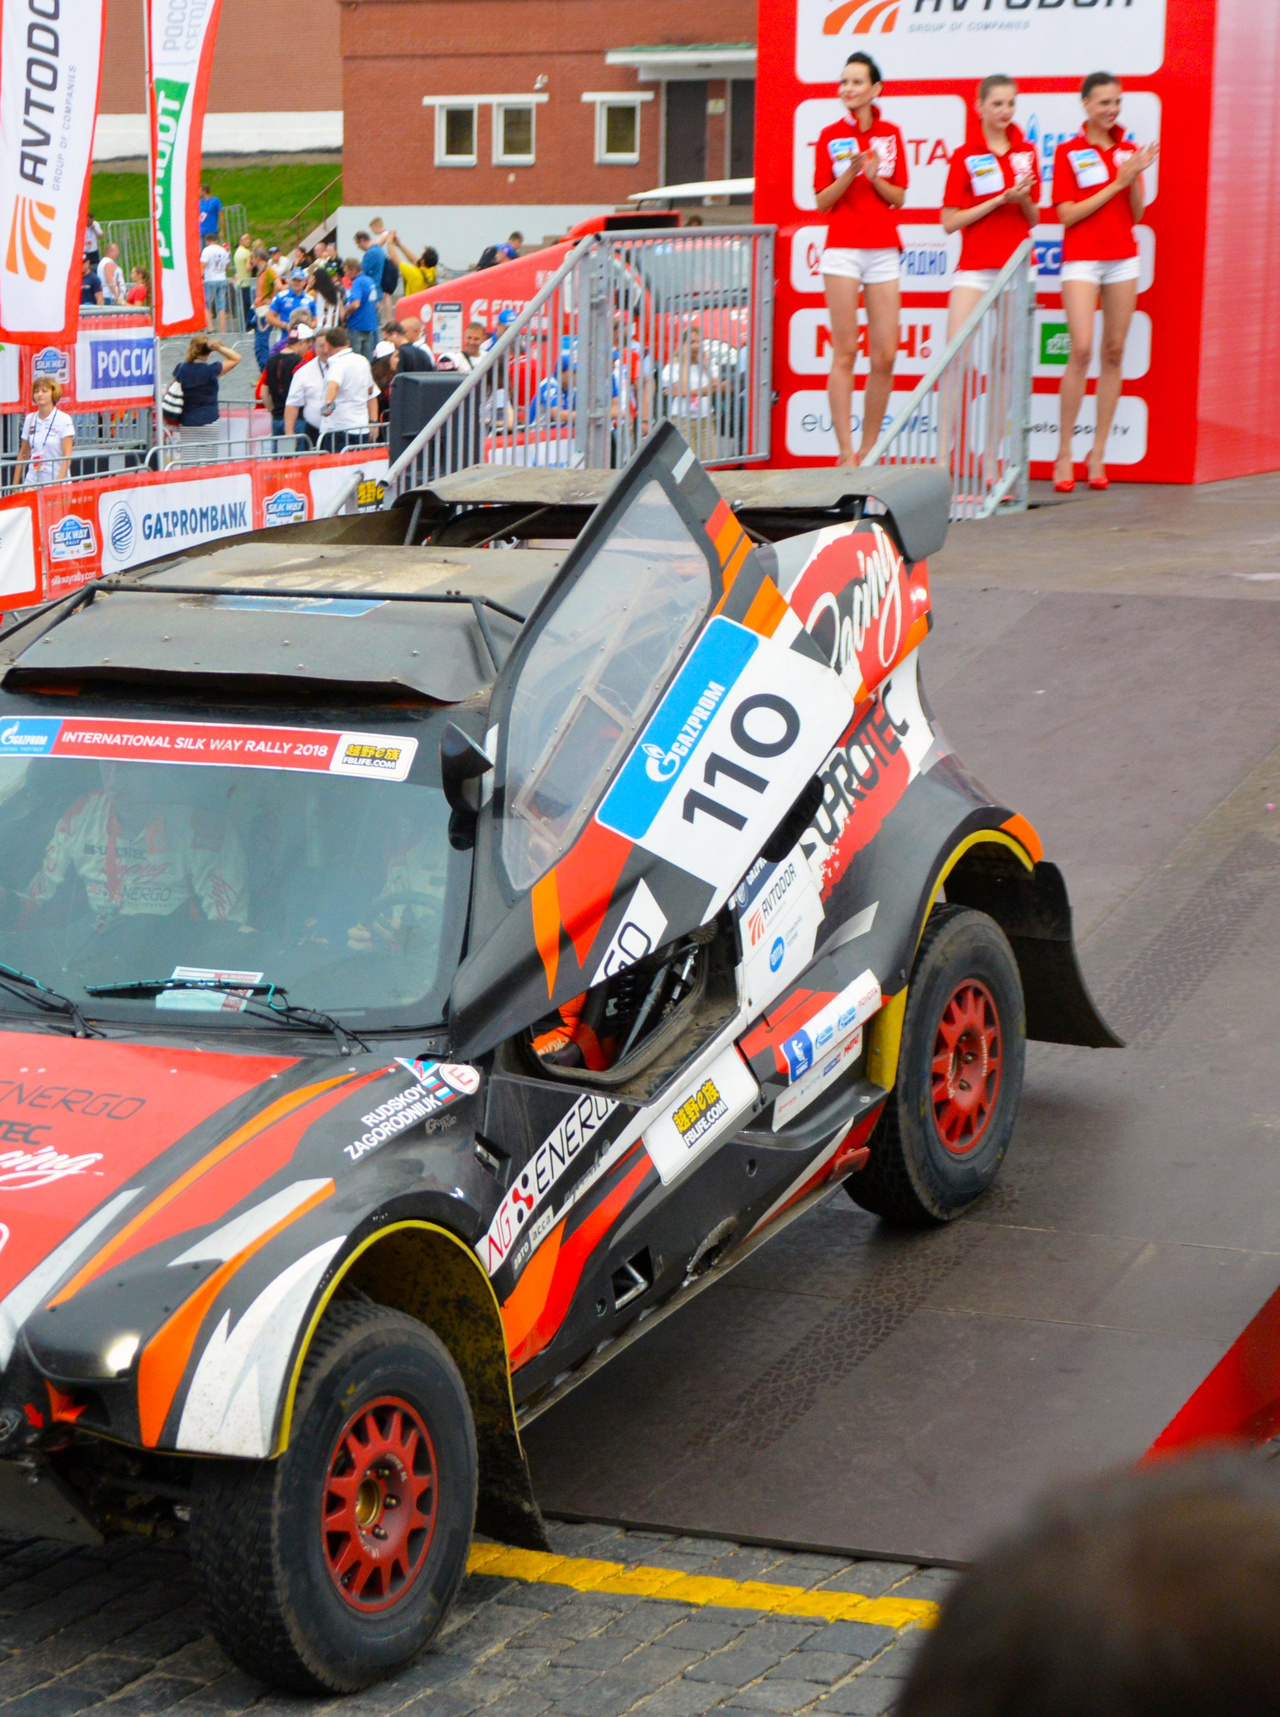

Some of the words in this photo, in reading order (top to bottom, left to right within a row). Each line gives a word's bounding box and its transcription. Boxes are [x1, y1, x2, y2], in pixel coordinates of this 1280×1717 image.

[908, 23, 946, 33] GROUP
[950, 21, 964, 32] OF
[967, 19, 1032, 31] COMPANIES
[63, 65, 77, 131] COMPANIES
[59, 136, 69, 149] OF
[52, 153, 64, 191] GROUP
[97, 348, 156, 378] РОССИ
[142, 501, 248, 541] GAZPROMBANK
[671, 680, 726, 758] GAZPROM
[61, 731, 172, 748] INTERNATIONAL
[174, 736, 206, 751] SILK
[209, 738, 243, 752] WAY
[244, 740, 292, 755] RALLY
[293, 743, 329, 758] 2018
[341, 756, 397, 770] FBLIFE.COM
[682, 692, 801, 832] 110
[761, 862, 797, 920] AVTODOR
[448, 1066, 474, 1087] E
[361, 1083, 427, 1127] RUDSKOY
[682, 1098, 730, 1149] FBLIFE.COM
[343, 1093, 443, 1161] ZAGORODNIUK
